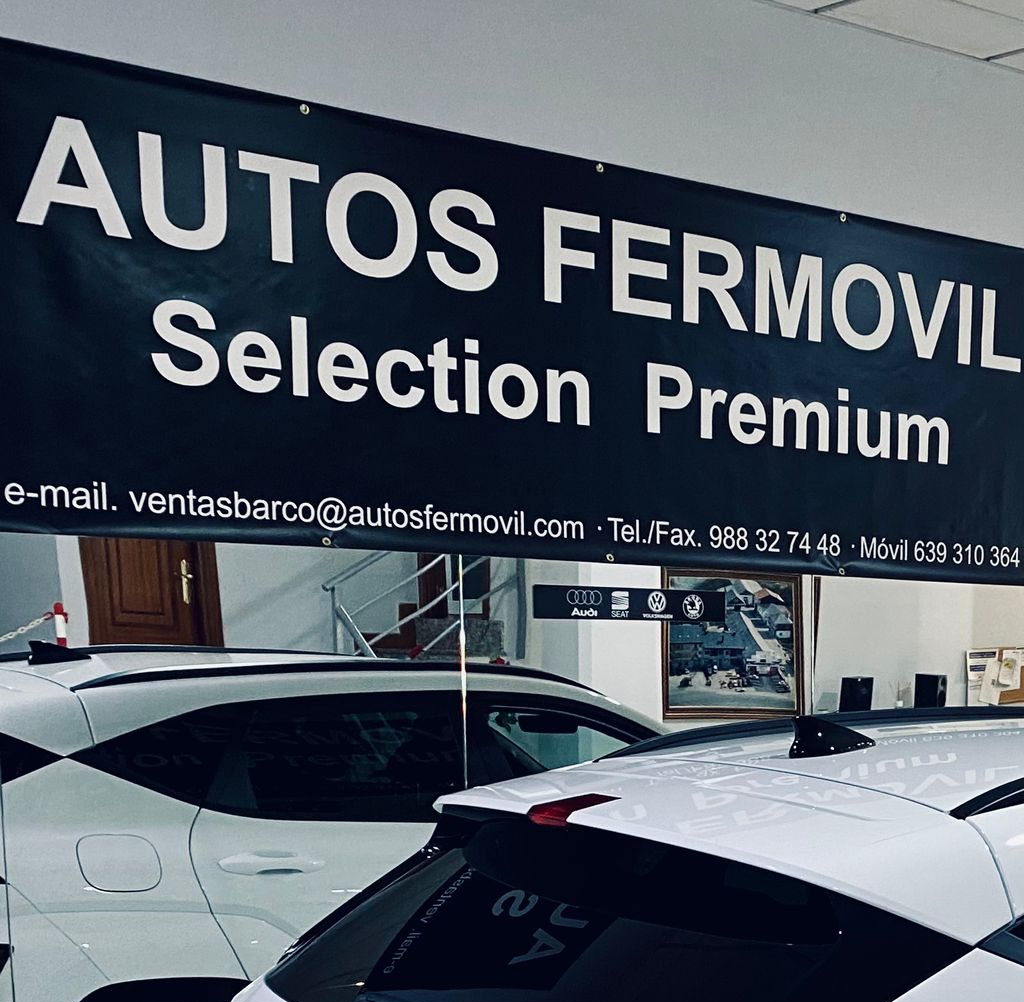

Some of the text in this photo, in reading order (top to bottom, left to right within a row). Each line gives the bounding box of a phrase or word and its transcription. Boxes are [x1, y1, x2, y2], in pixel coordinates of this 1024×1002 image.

[16, 115, 1022, 373] AUTOS FERMOVIL
[150, 299, 950, 465] Selection Premium
[4, 481, 1021, 568] e-mail. ventasbarco@autosfermovil.com Tel./Fax. 988 32 74 48 Móvil 639 310 364
[571, 607, 598, 617] Audi
[611, 610, 630, 618] SEAT
